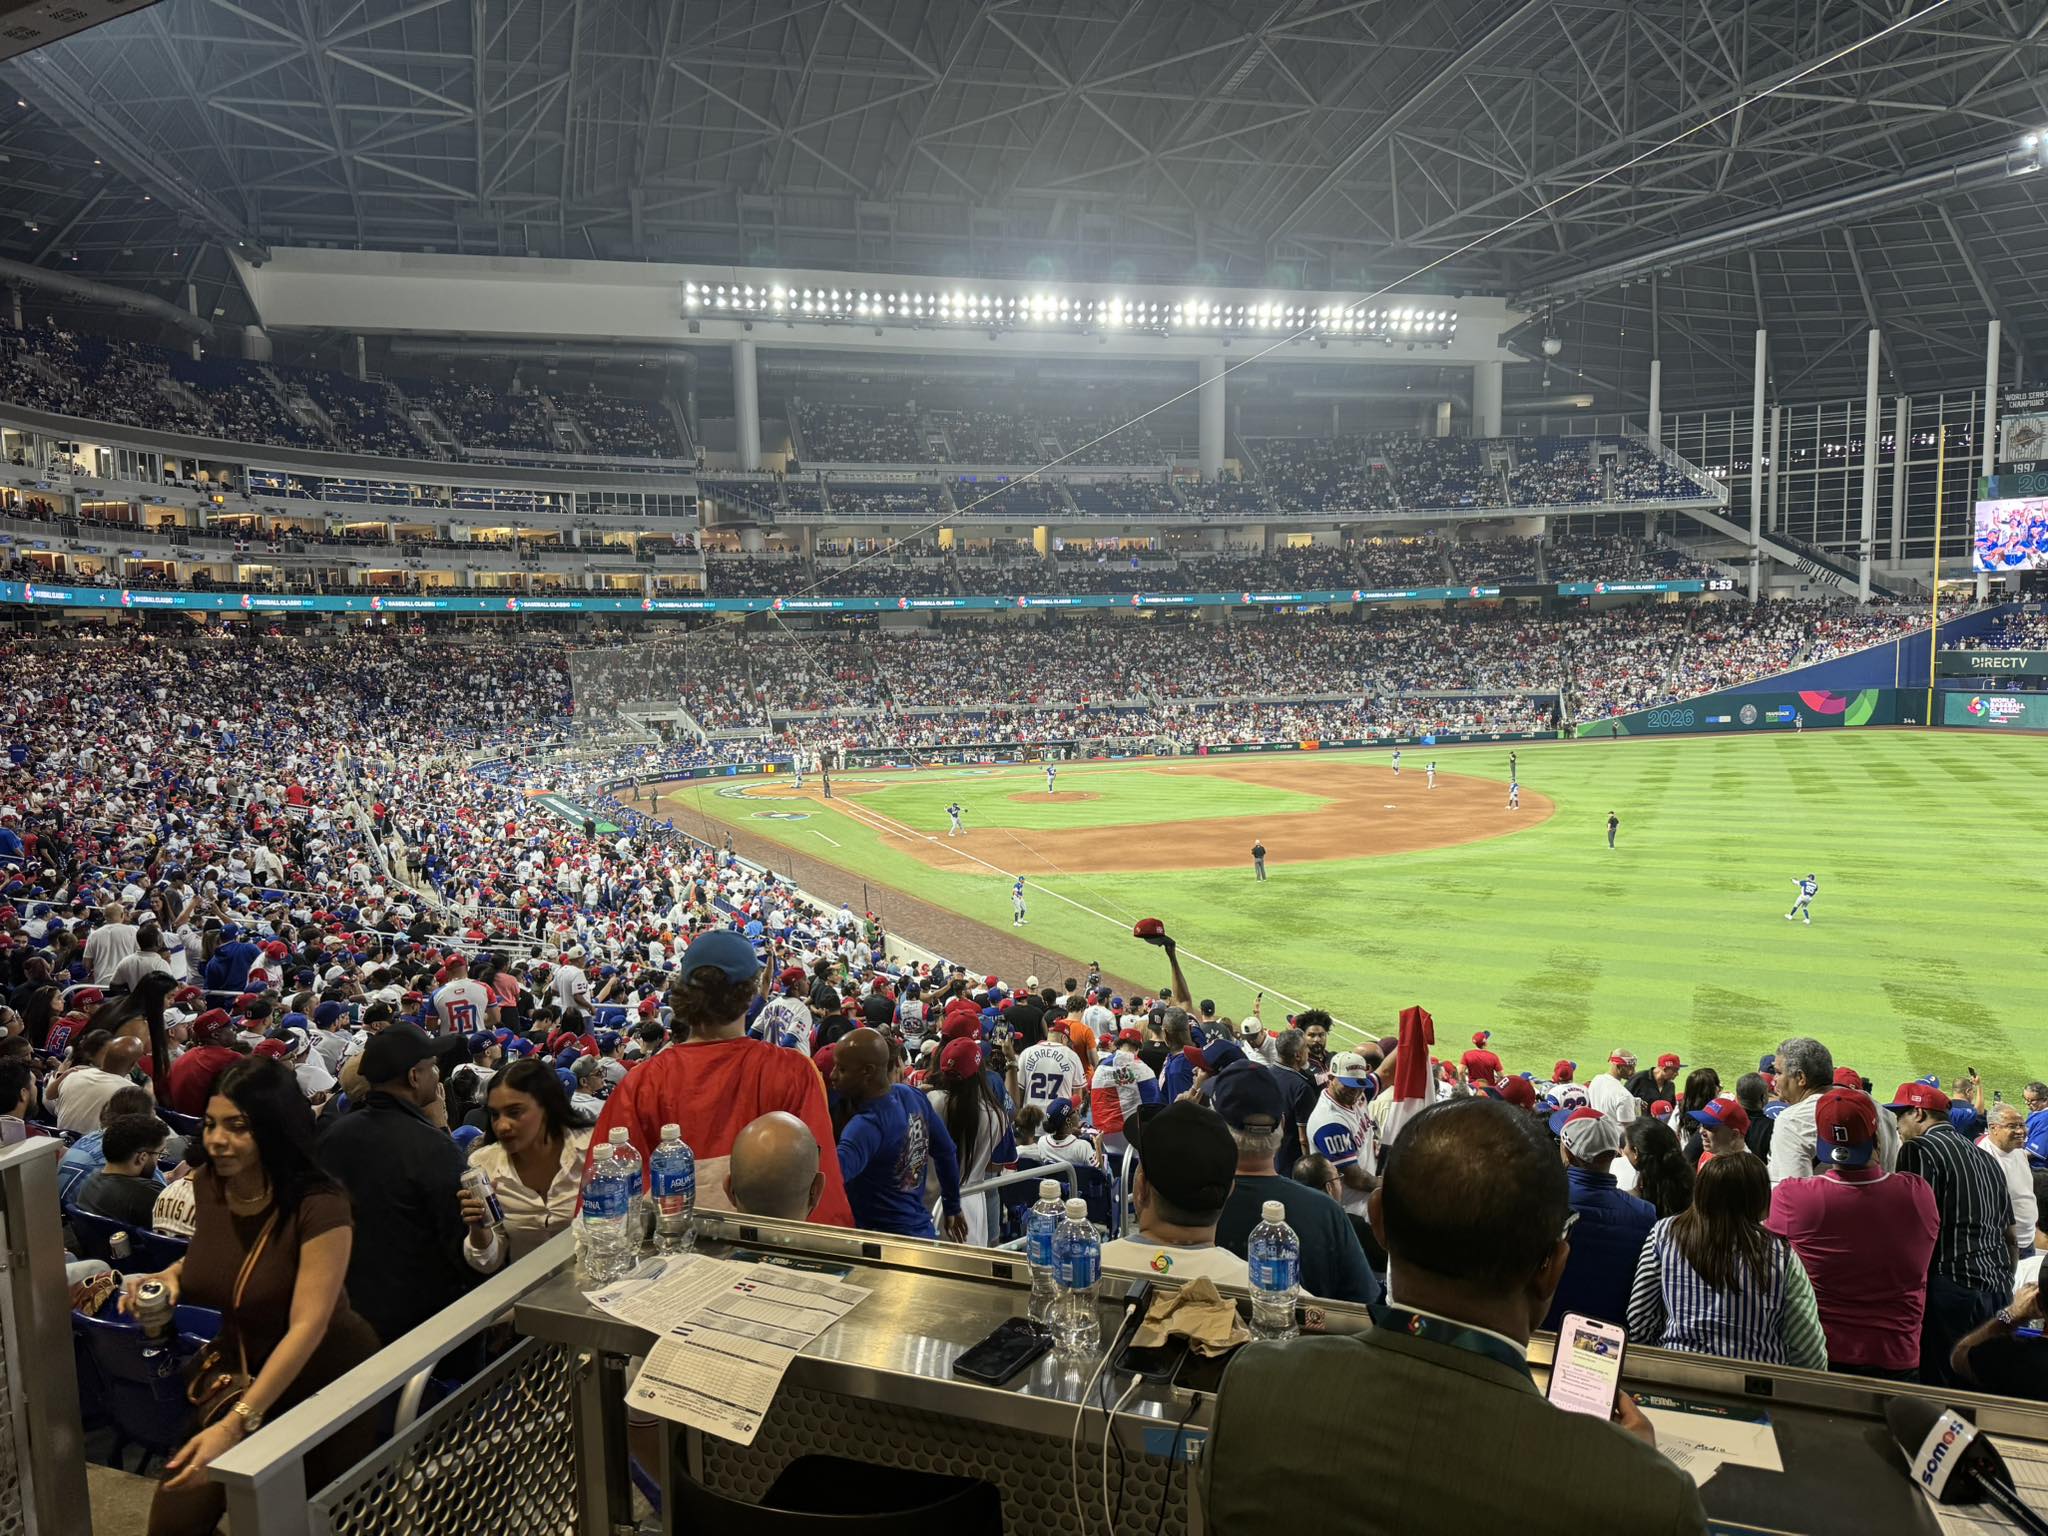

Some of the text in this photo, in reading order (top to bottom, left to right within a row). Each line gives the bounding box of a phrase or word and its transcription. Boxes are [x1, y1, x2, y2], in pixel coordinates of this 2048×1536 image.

[2005, 393, 2027, 401] WORLD
[2009, 399, 2045, 409] CHAMPIONS
[2013, 463, 2036, 474] 1997
[1709, 580, 1733, 591] 9:53
[1814, 566, 1842, 589] LEVEL
[1971, 657, 2028, 668] DIRECTV
[1648, 709, 1695, 728] 2026
[1026, 1048, 1071, 1073] GUERRERO JR
[1030, 1073, 1064, 1100] 27
[1324, 1133, 1353, 1155] DOM
[1922, 1420, 1965, 1486] somos
